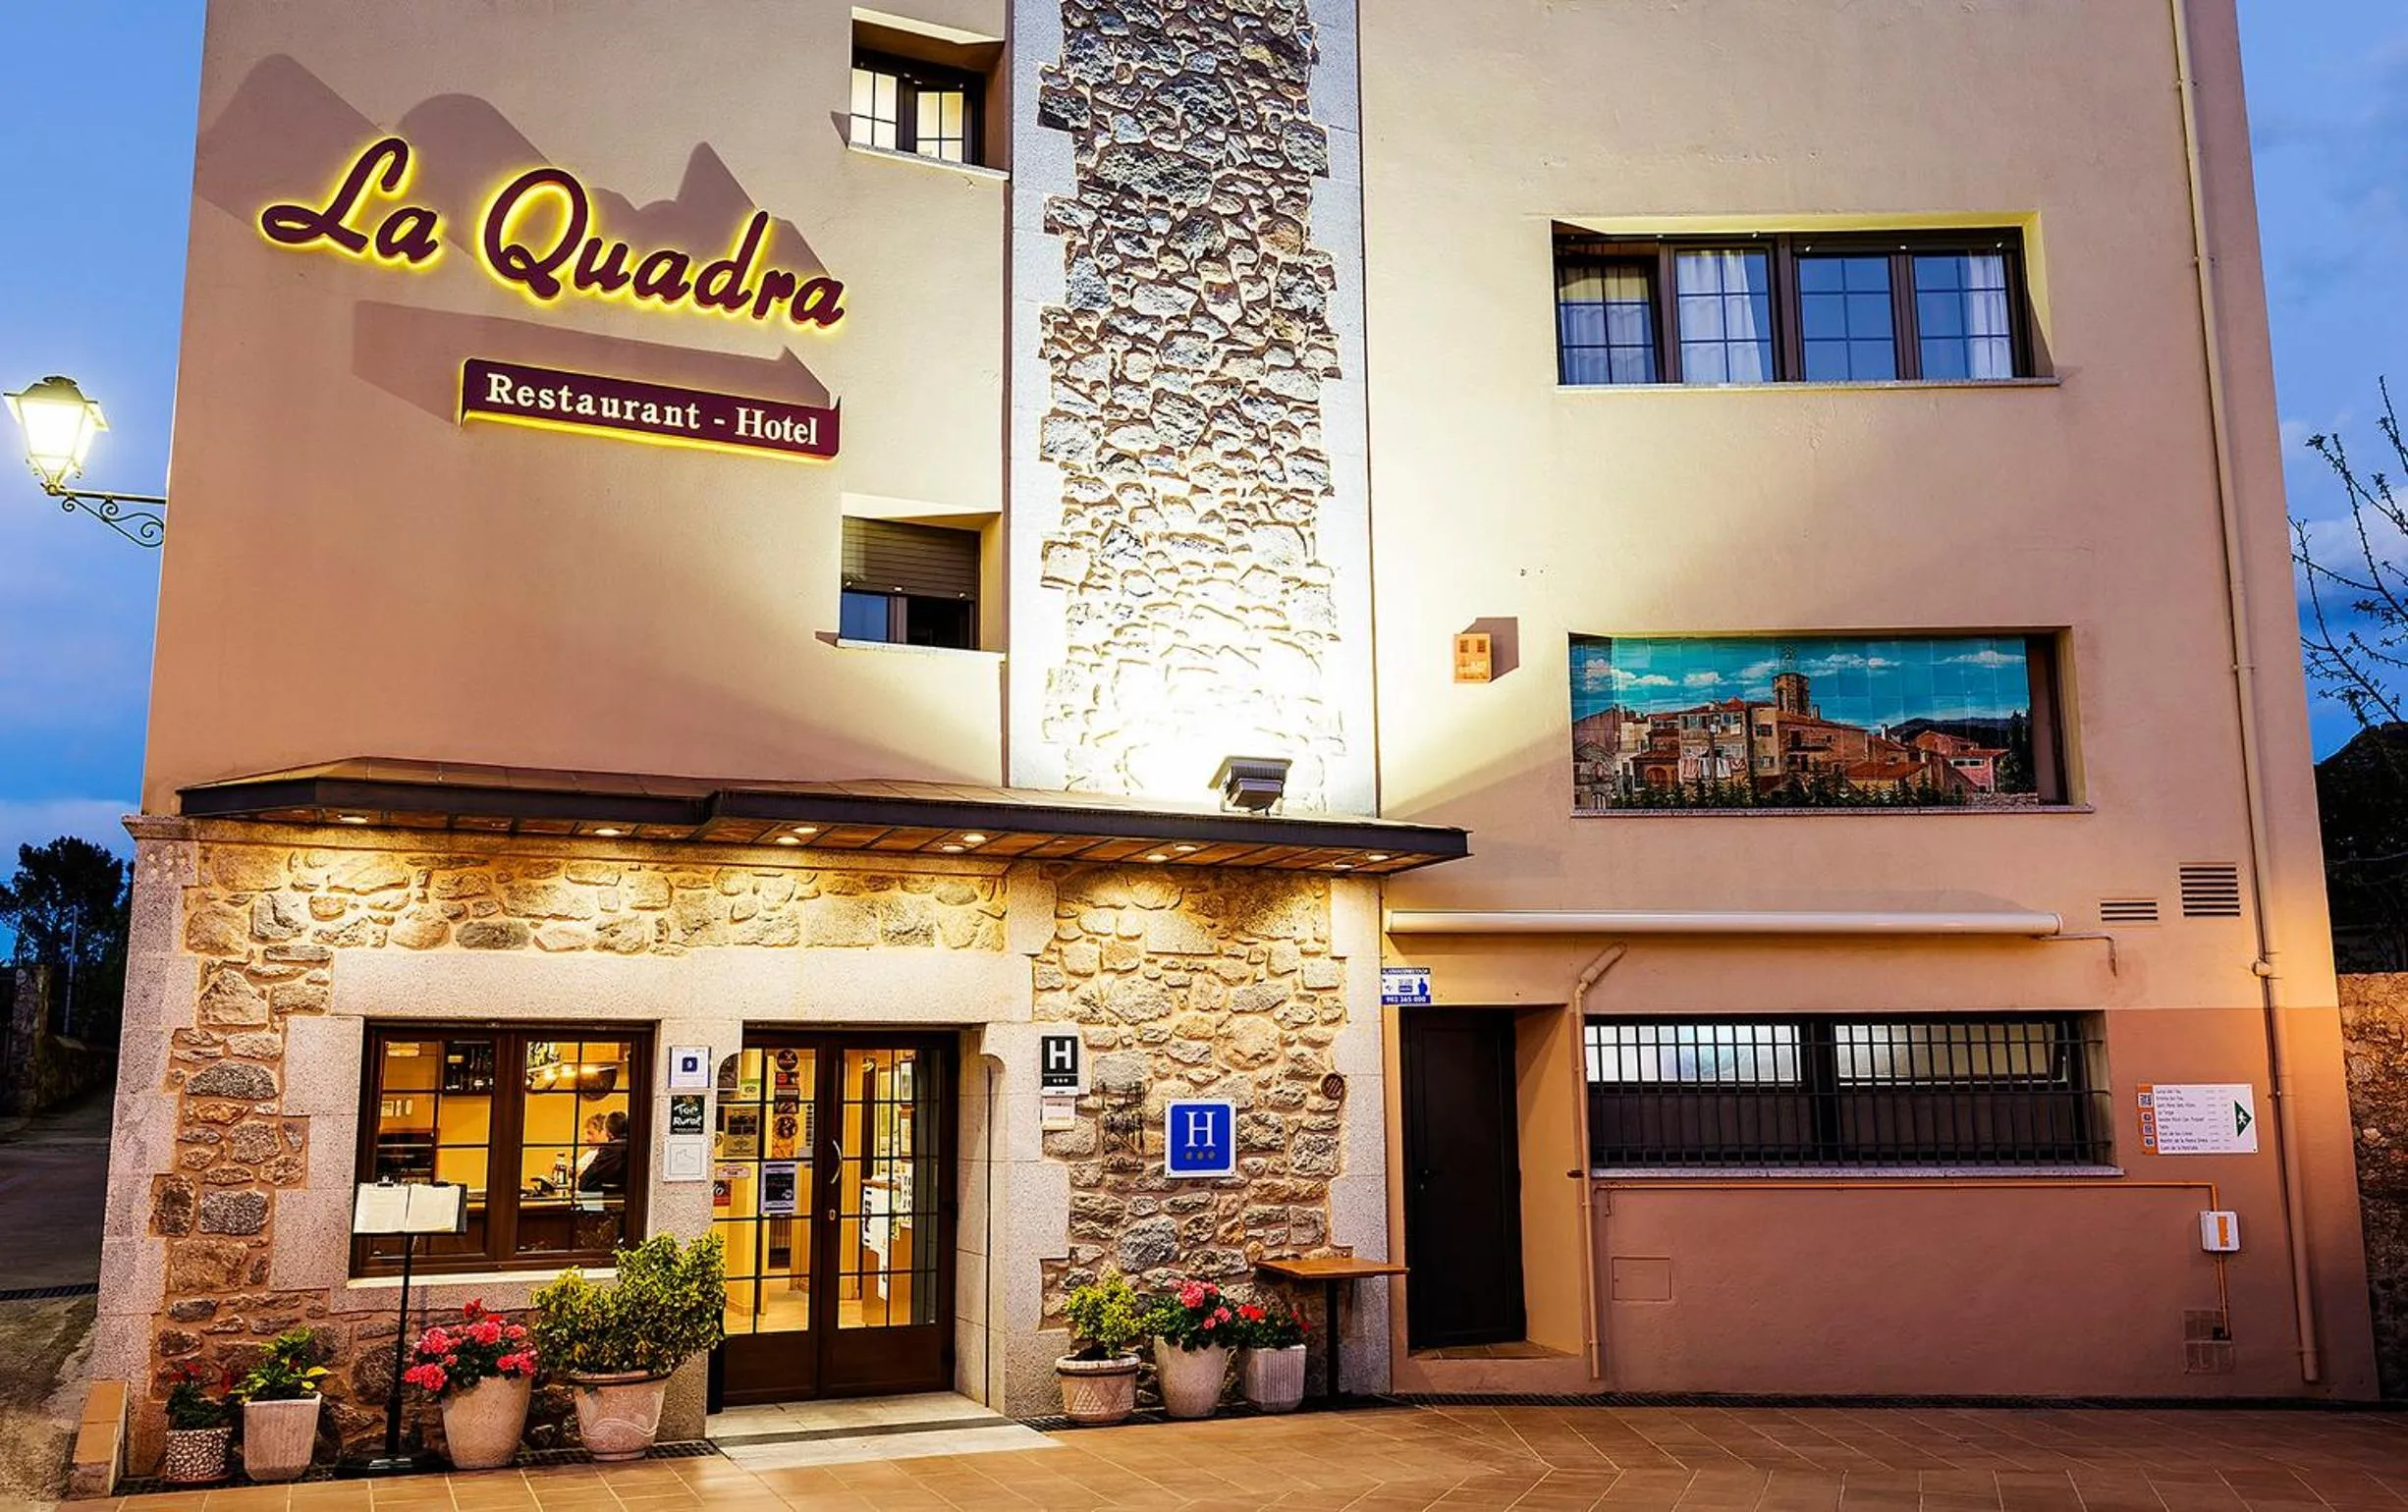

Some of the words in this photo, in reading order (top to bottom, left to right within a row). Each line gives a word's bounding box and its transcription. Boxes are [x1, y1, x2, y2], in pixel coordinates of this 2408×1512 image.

[260, 136, 439, 264] La
[483, 167, 846, 329] Quadra
[485, 372, 701, 430] Restaurant
[713, 416, 726, 426] -
[736, 405, 819, 446] Hotel
[1049, 1040, 1071, 1069] H
[1184, 1111, 1217, 1147] H
